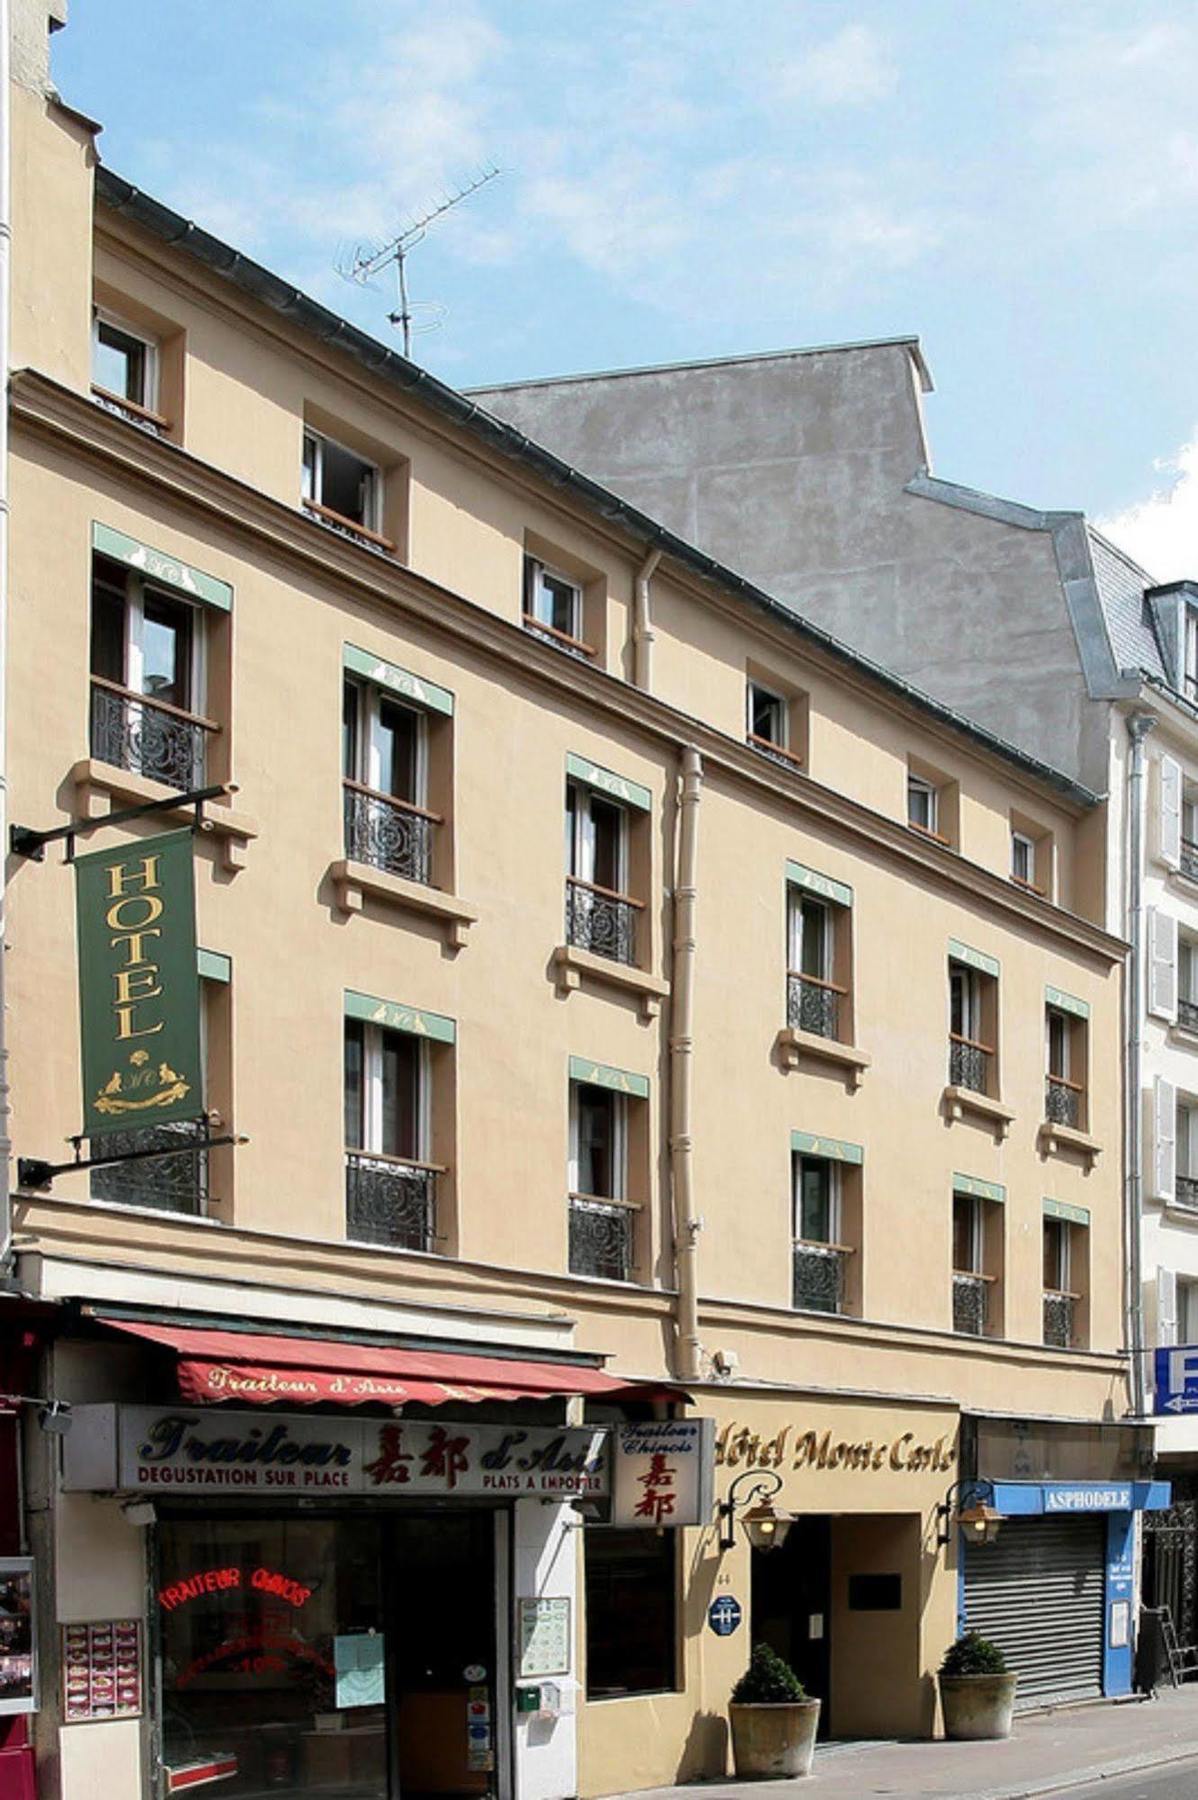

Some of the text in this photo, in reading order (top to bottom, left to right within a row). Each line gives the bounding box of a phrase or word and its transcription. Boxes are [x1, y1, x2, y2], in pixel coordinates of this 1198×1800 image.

[105, 854, 164, 1041] HOTEL
[208, 1368, 318, 1393] Traiteur
[138, 1416, 351, 1466] Traiteur
[363, 1424, 470, 1489] 嘉都
[481, 1431, 605, 1472] d'Asie
[623, 1440, 693, 1454] Chinois
[793, 1430, 887, 1471] Monte
[889, 1432, 956, 1473] Carlo
[138, 1466, 349, 1487] DEGUSTATION SUR PLACE
[483, 1475, 601, 1491] PLATS A EMPORTER
[1047, 1490, 1130, 1509] ASPHODELE
[157, 1567, 241, 1611] TRAITEUR
